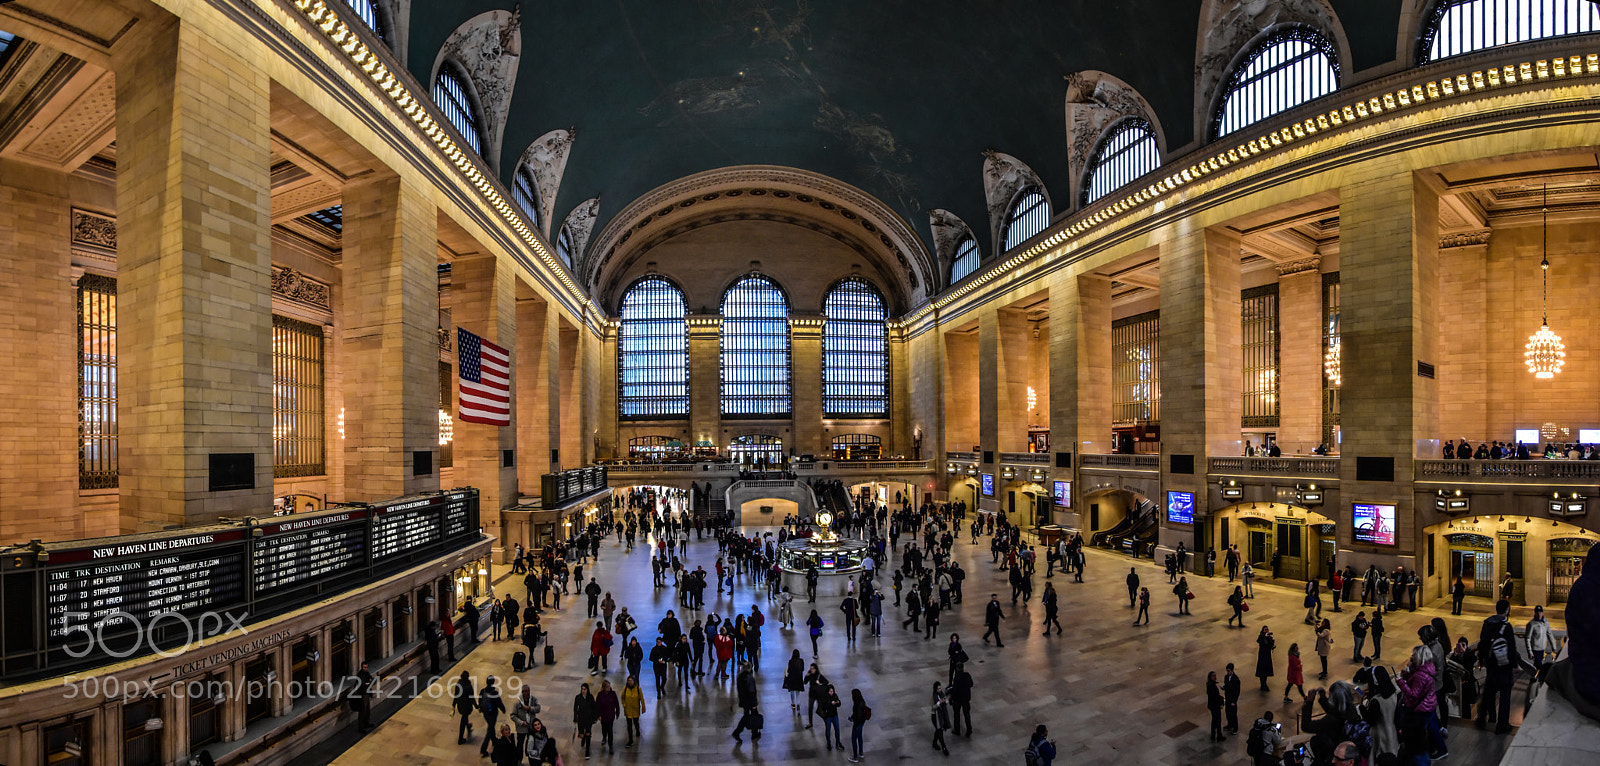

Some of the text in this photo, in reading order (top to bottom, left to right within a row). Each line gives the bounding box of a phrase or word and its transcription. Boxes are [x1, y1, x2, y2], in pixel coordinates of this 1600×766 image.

[280, 514, 350, 532] NEW HAVEN LINE DEPARTURES
[93, 535, 214, 558] NEW HAVEN LINE DEPARTURES
[50, 556, 180, 580] TIME TRK DESTINATION REMARKS
[49, 582, 68, 592] 11:04
[92, 578, 104, 586] NEW
[106, 575, 123, 584] HAVEN
[49, 594, 67, 603] 11:07
[93, 586, 120, 597] STAMFORD
[148, 578, 163, 587] MOUNT
[166, 575, 182, 584] VERNON
[199, 570, 210, 578] STOP
[49, 605, 68, 614] 11:34
[106, 596, 123, 605] HAVEN
[148, 586, 178, 597] CONNECTION
[50, 616, 68, 625] 11:37
[93, 606, 120, 618] STAMFORD
[148, 598, 163, 608] MOUNT
[166, 594, 182, 604] VERNON
[199, 588, 210, 597] STOP
[106, 617, 123, 626] HAVEN
[171, 604, 180, 612] NEW
[173, 629, 291, 678] TICKET VENDING MACHINES
